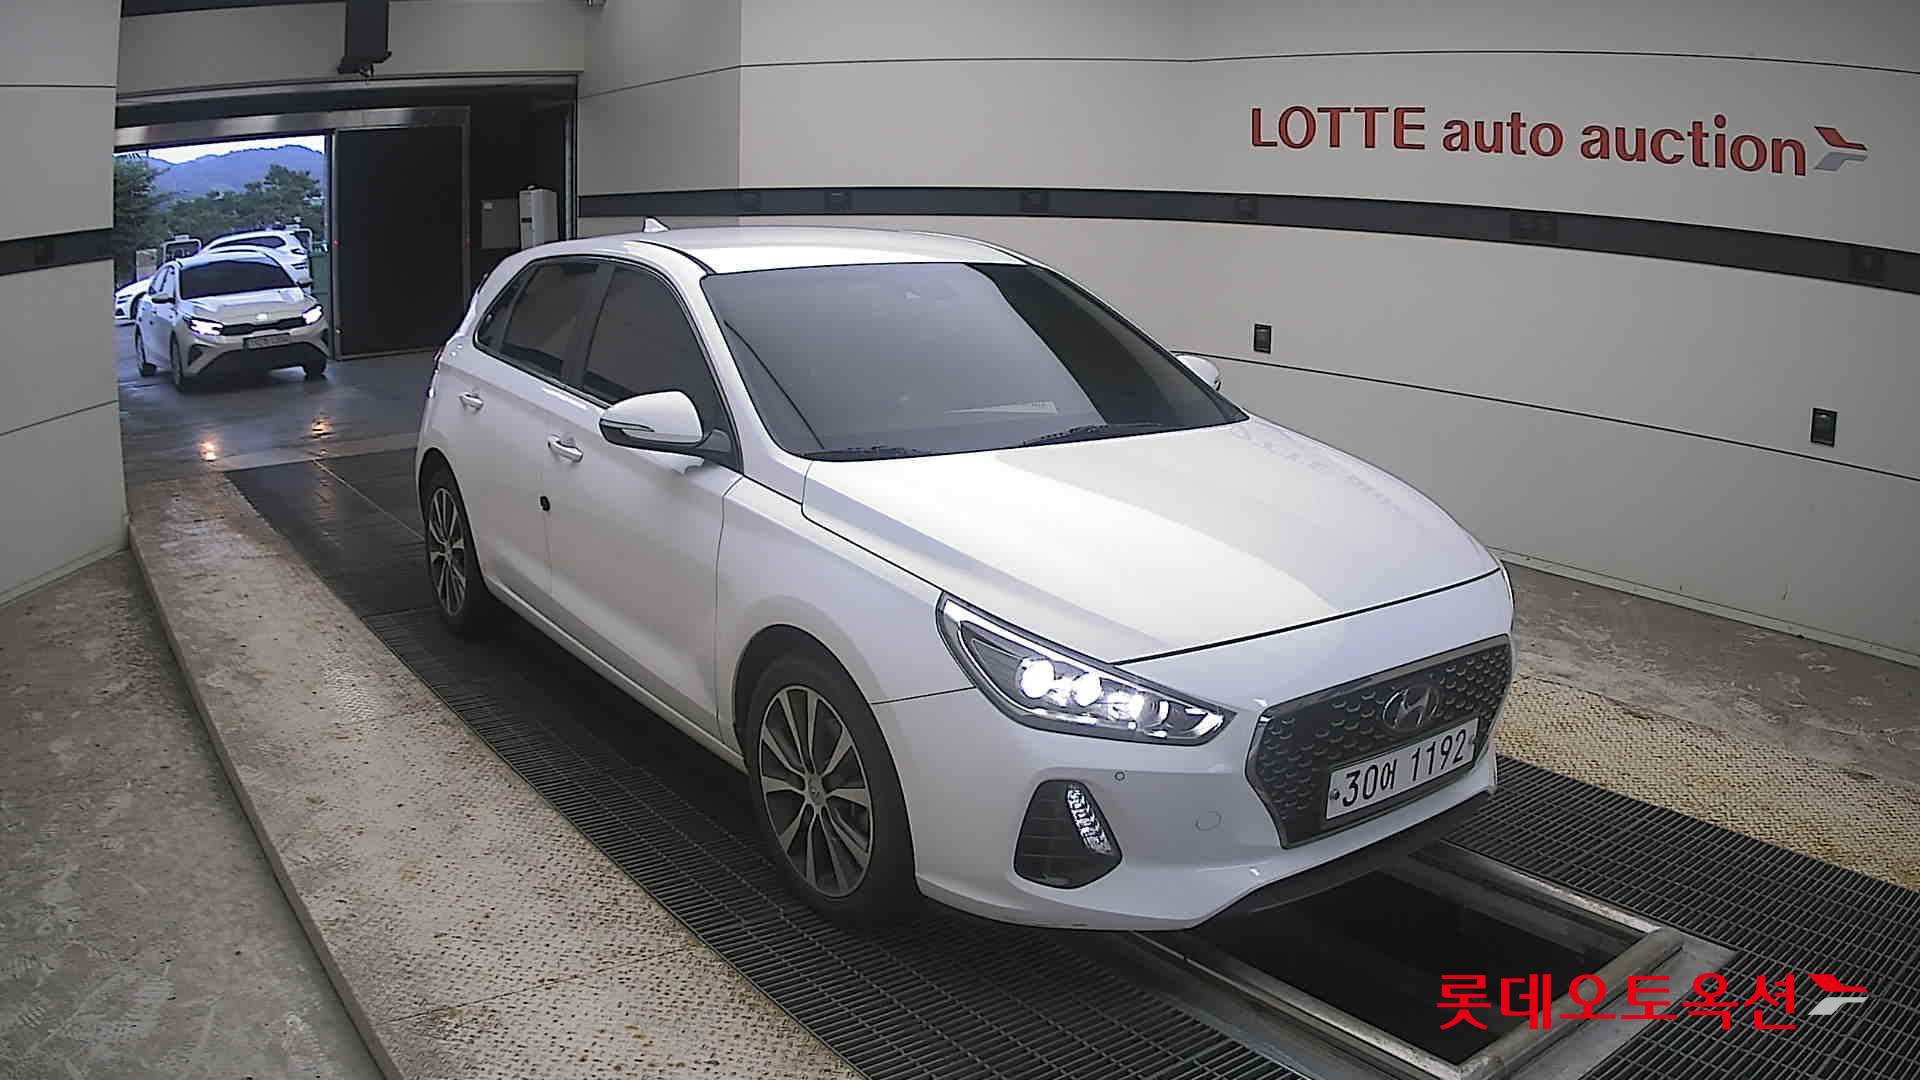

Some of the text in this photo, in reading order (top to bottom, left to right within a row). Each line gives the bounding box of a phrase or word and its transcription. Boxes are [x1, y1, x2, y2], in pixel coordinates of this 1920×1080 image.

[1251, 105, 1807, 177] LOTTE auto auction
[1342, 728, 1467, 808] 30어 1192
